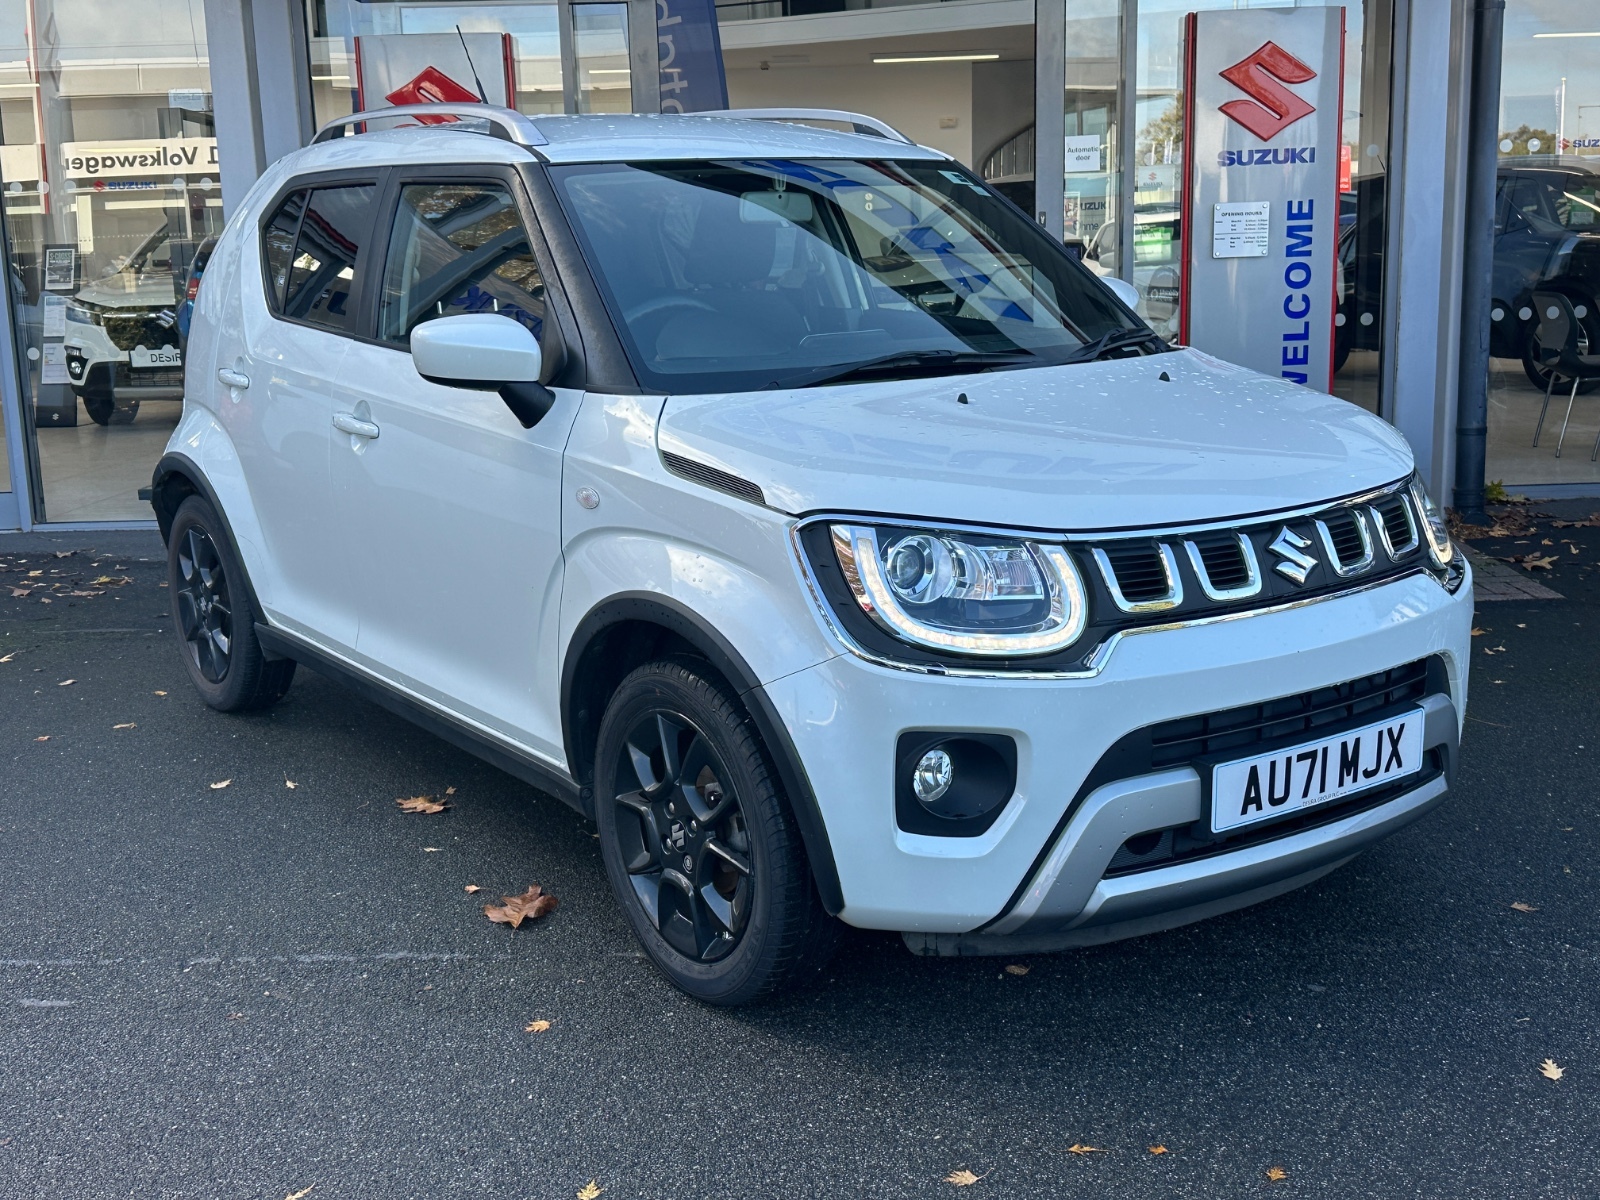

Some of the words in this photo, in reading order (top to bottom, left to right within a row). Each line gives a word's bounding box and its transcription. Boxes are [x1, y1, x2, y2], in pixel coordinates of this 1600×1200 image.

[1217, 147, 1316, 167] SUZUKI
[107, 181, 158, 190] SUZUKI
[1240, 746, 1329, 816] AU71
[1337, 722, 1406, 788] MJX
